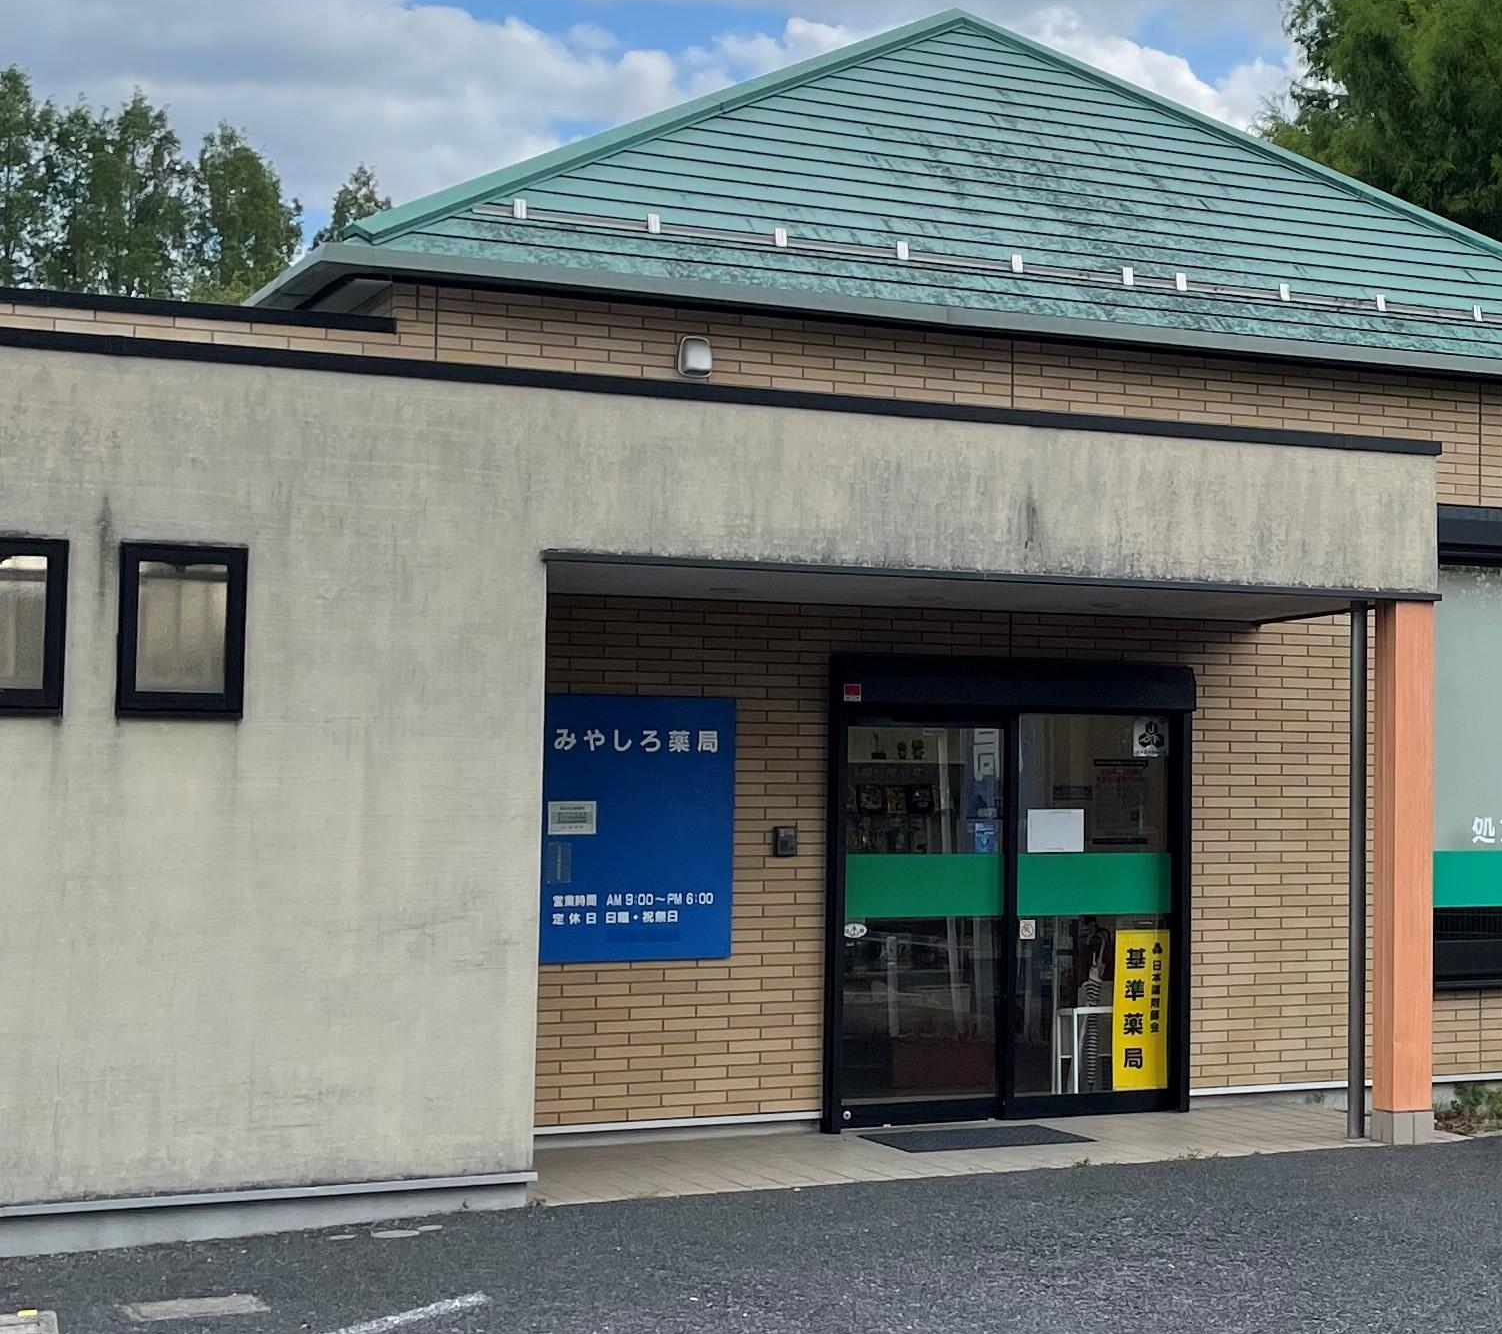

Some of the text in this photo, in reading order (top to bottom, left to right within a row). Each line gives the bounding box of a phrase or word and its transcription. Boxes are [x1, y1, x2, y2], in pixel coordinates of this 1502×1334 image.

[553, 728, 719, 753] みやしろ薬局
[1123, 947, 1146, 1070] 基準薬局
